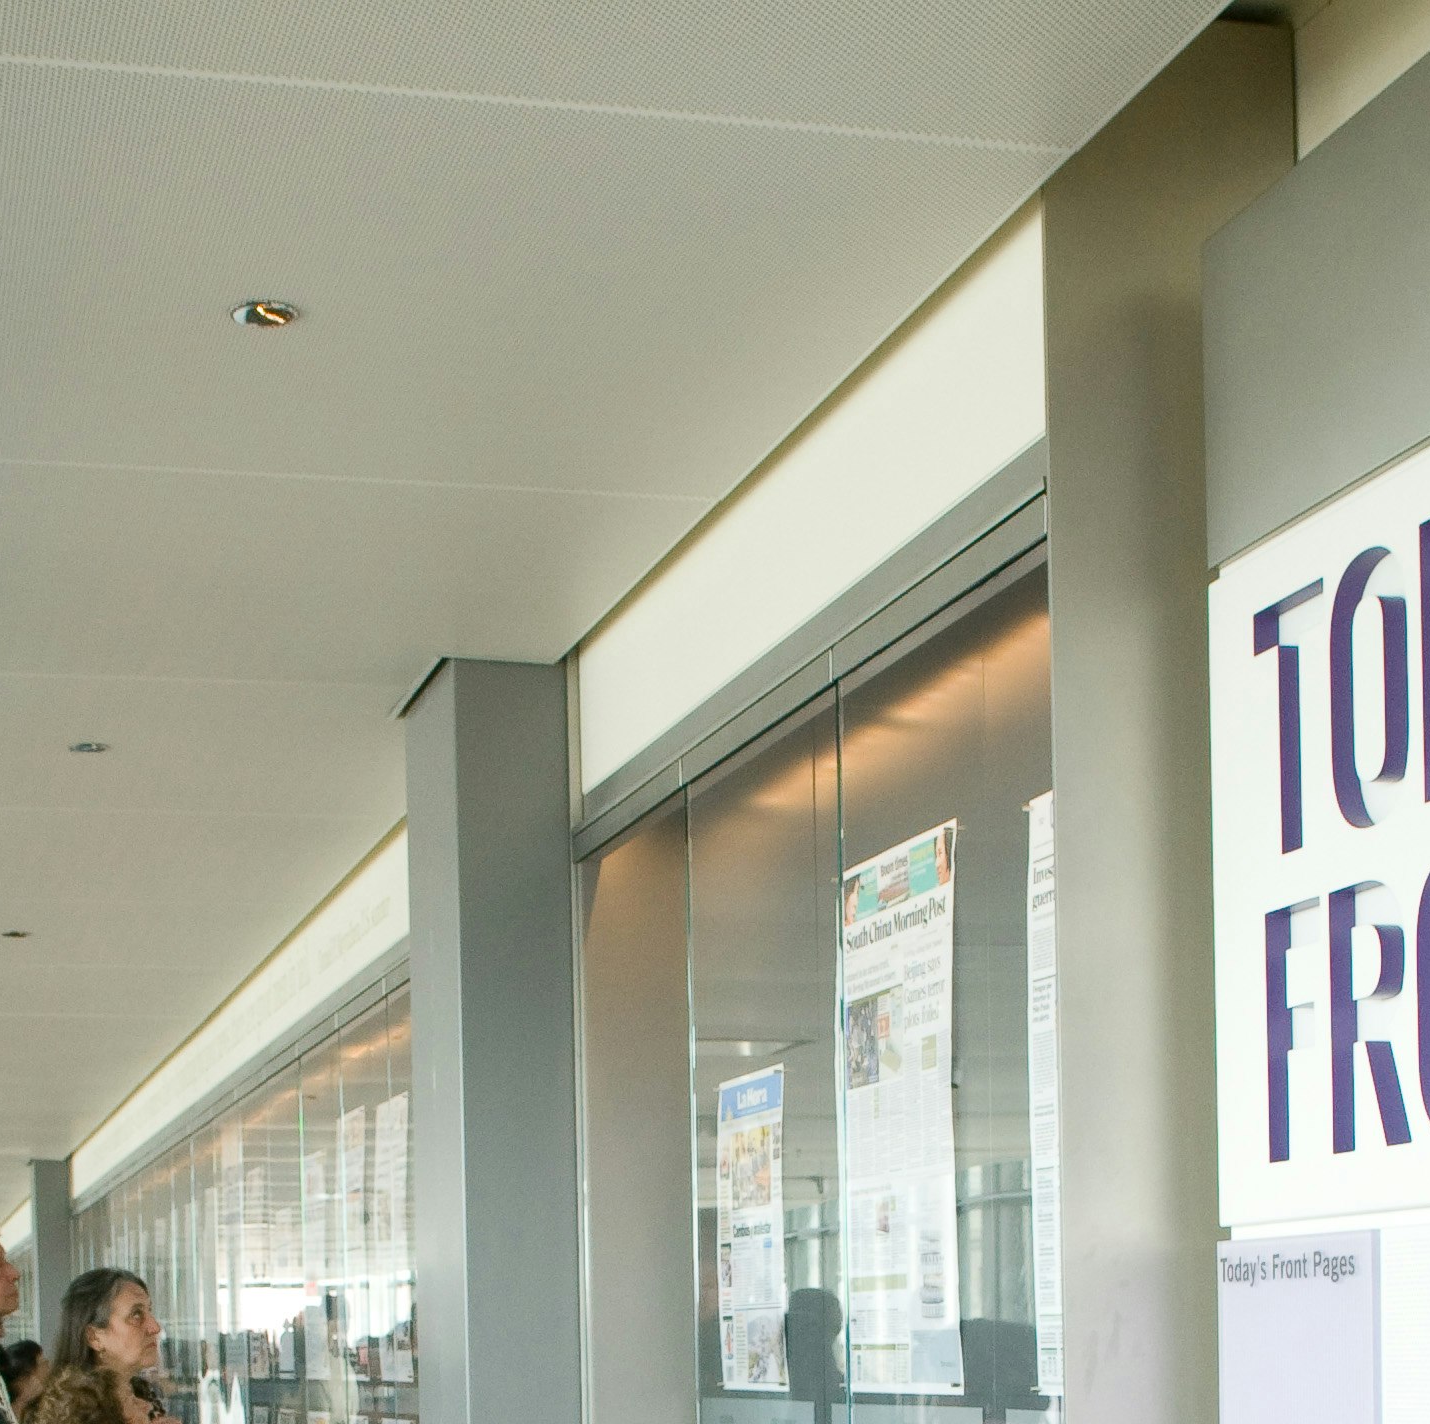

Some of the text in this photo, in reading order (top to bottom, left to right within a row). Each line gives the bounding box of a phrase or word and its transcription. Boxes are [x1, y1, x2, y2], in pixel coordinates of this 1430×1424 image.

[846, 896, 946, 952] South China Morning Post
[904, 984, 927, 1005] Games
[1220, 1250, 1356, 1288] Today's Front Pages
